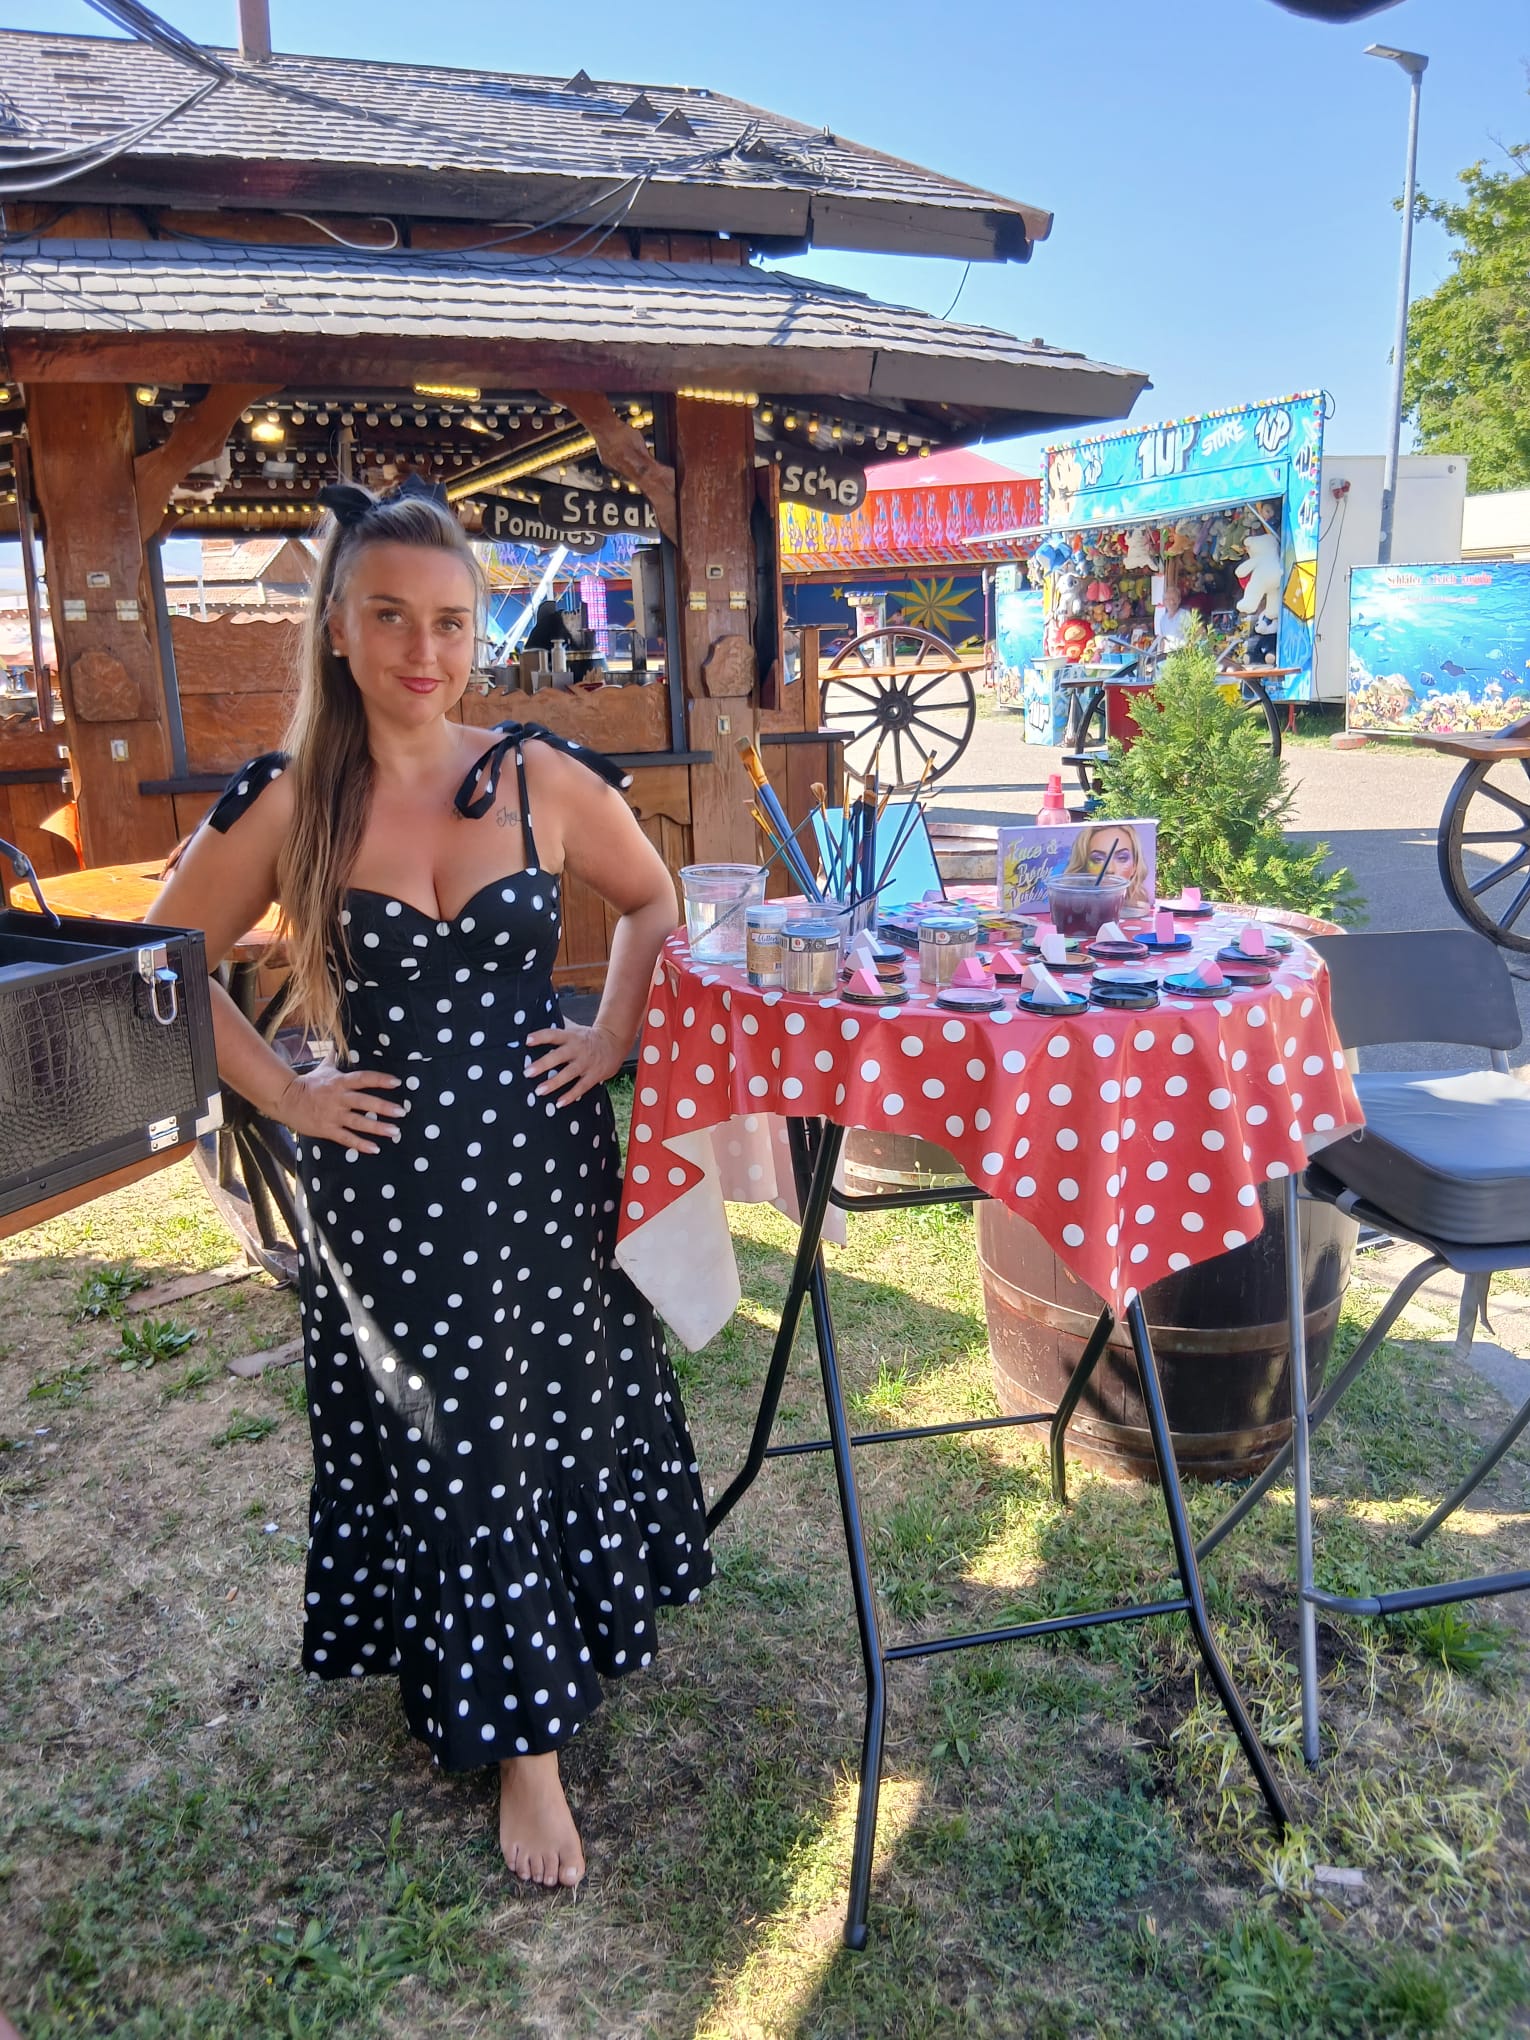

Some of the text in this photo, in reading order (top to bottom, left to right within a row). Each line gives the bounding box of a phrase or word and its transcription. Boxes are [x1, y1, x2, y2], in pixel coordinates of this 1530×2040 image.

[1254, 406, 1292, 452] 1UP
[1137, 423, 1199, 480] 1UP
[562, 491, 657, 528] Steak
[1016, 858, 1053, 891] Body
